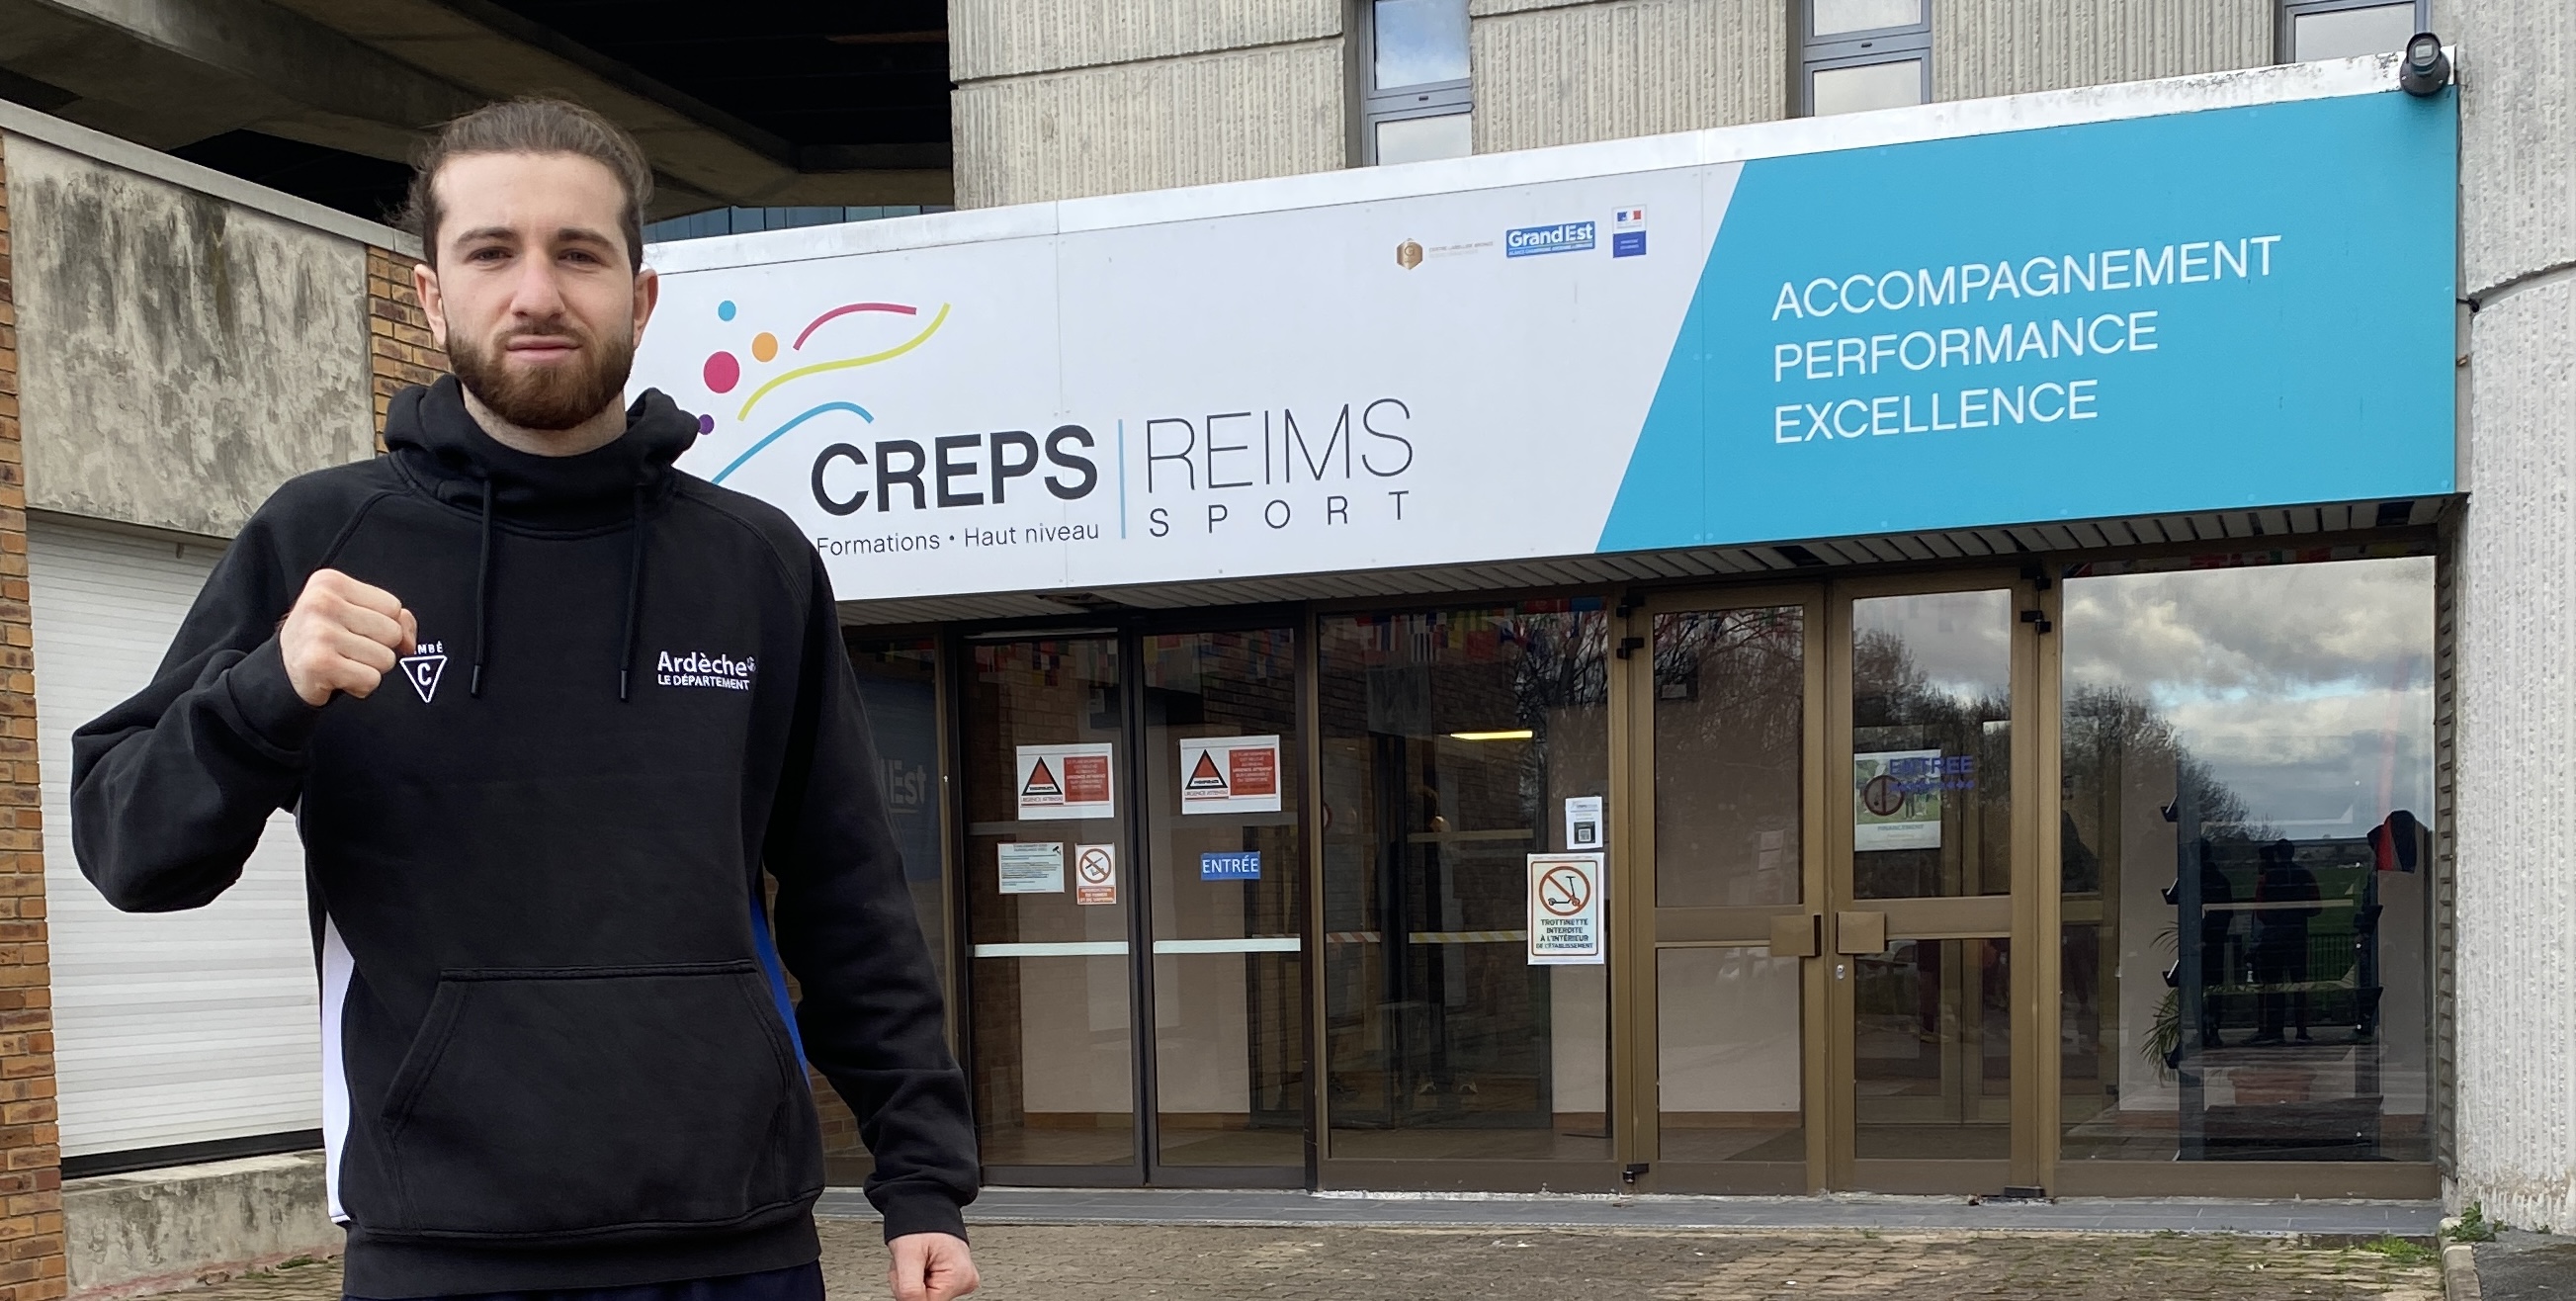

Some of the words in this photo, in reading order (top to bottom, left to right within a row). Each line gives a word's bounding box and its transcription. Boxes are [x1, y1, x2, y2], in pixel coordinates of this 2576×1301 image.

[1508, 225, 1564, 247] Grand
[1565, 223, 1593, 242] Est
[1771, 235, 2281, 321] ACCOMPAGNEMENT
[1774, 310, 2159, 383] PERFORMANCE
[1774, 379, 2099, 443] EXCELLENCE
[1146, 397, 1414, 493] REIMS
[811, 424, 1098, 516] CREPS
[1149, 490, 1410, 538] SPORT
[817, 528, 940, 557] Formations
[964, 526, 1017, 549] Haut
[1025, 522, 1100, 545] niveau
[414, 641, 444, 654] MBÉ
[656, 650, 747, 677] Ardèche
[417, 662, 432, 686] C
[657, 674, 672, 686] LE
[673, 673, 750, 690] DÉPARTEMENT
[1202, 855, 1258, 874] ENTRÉE
